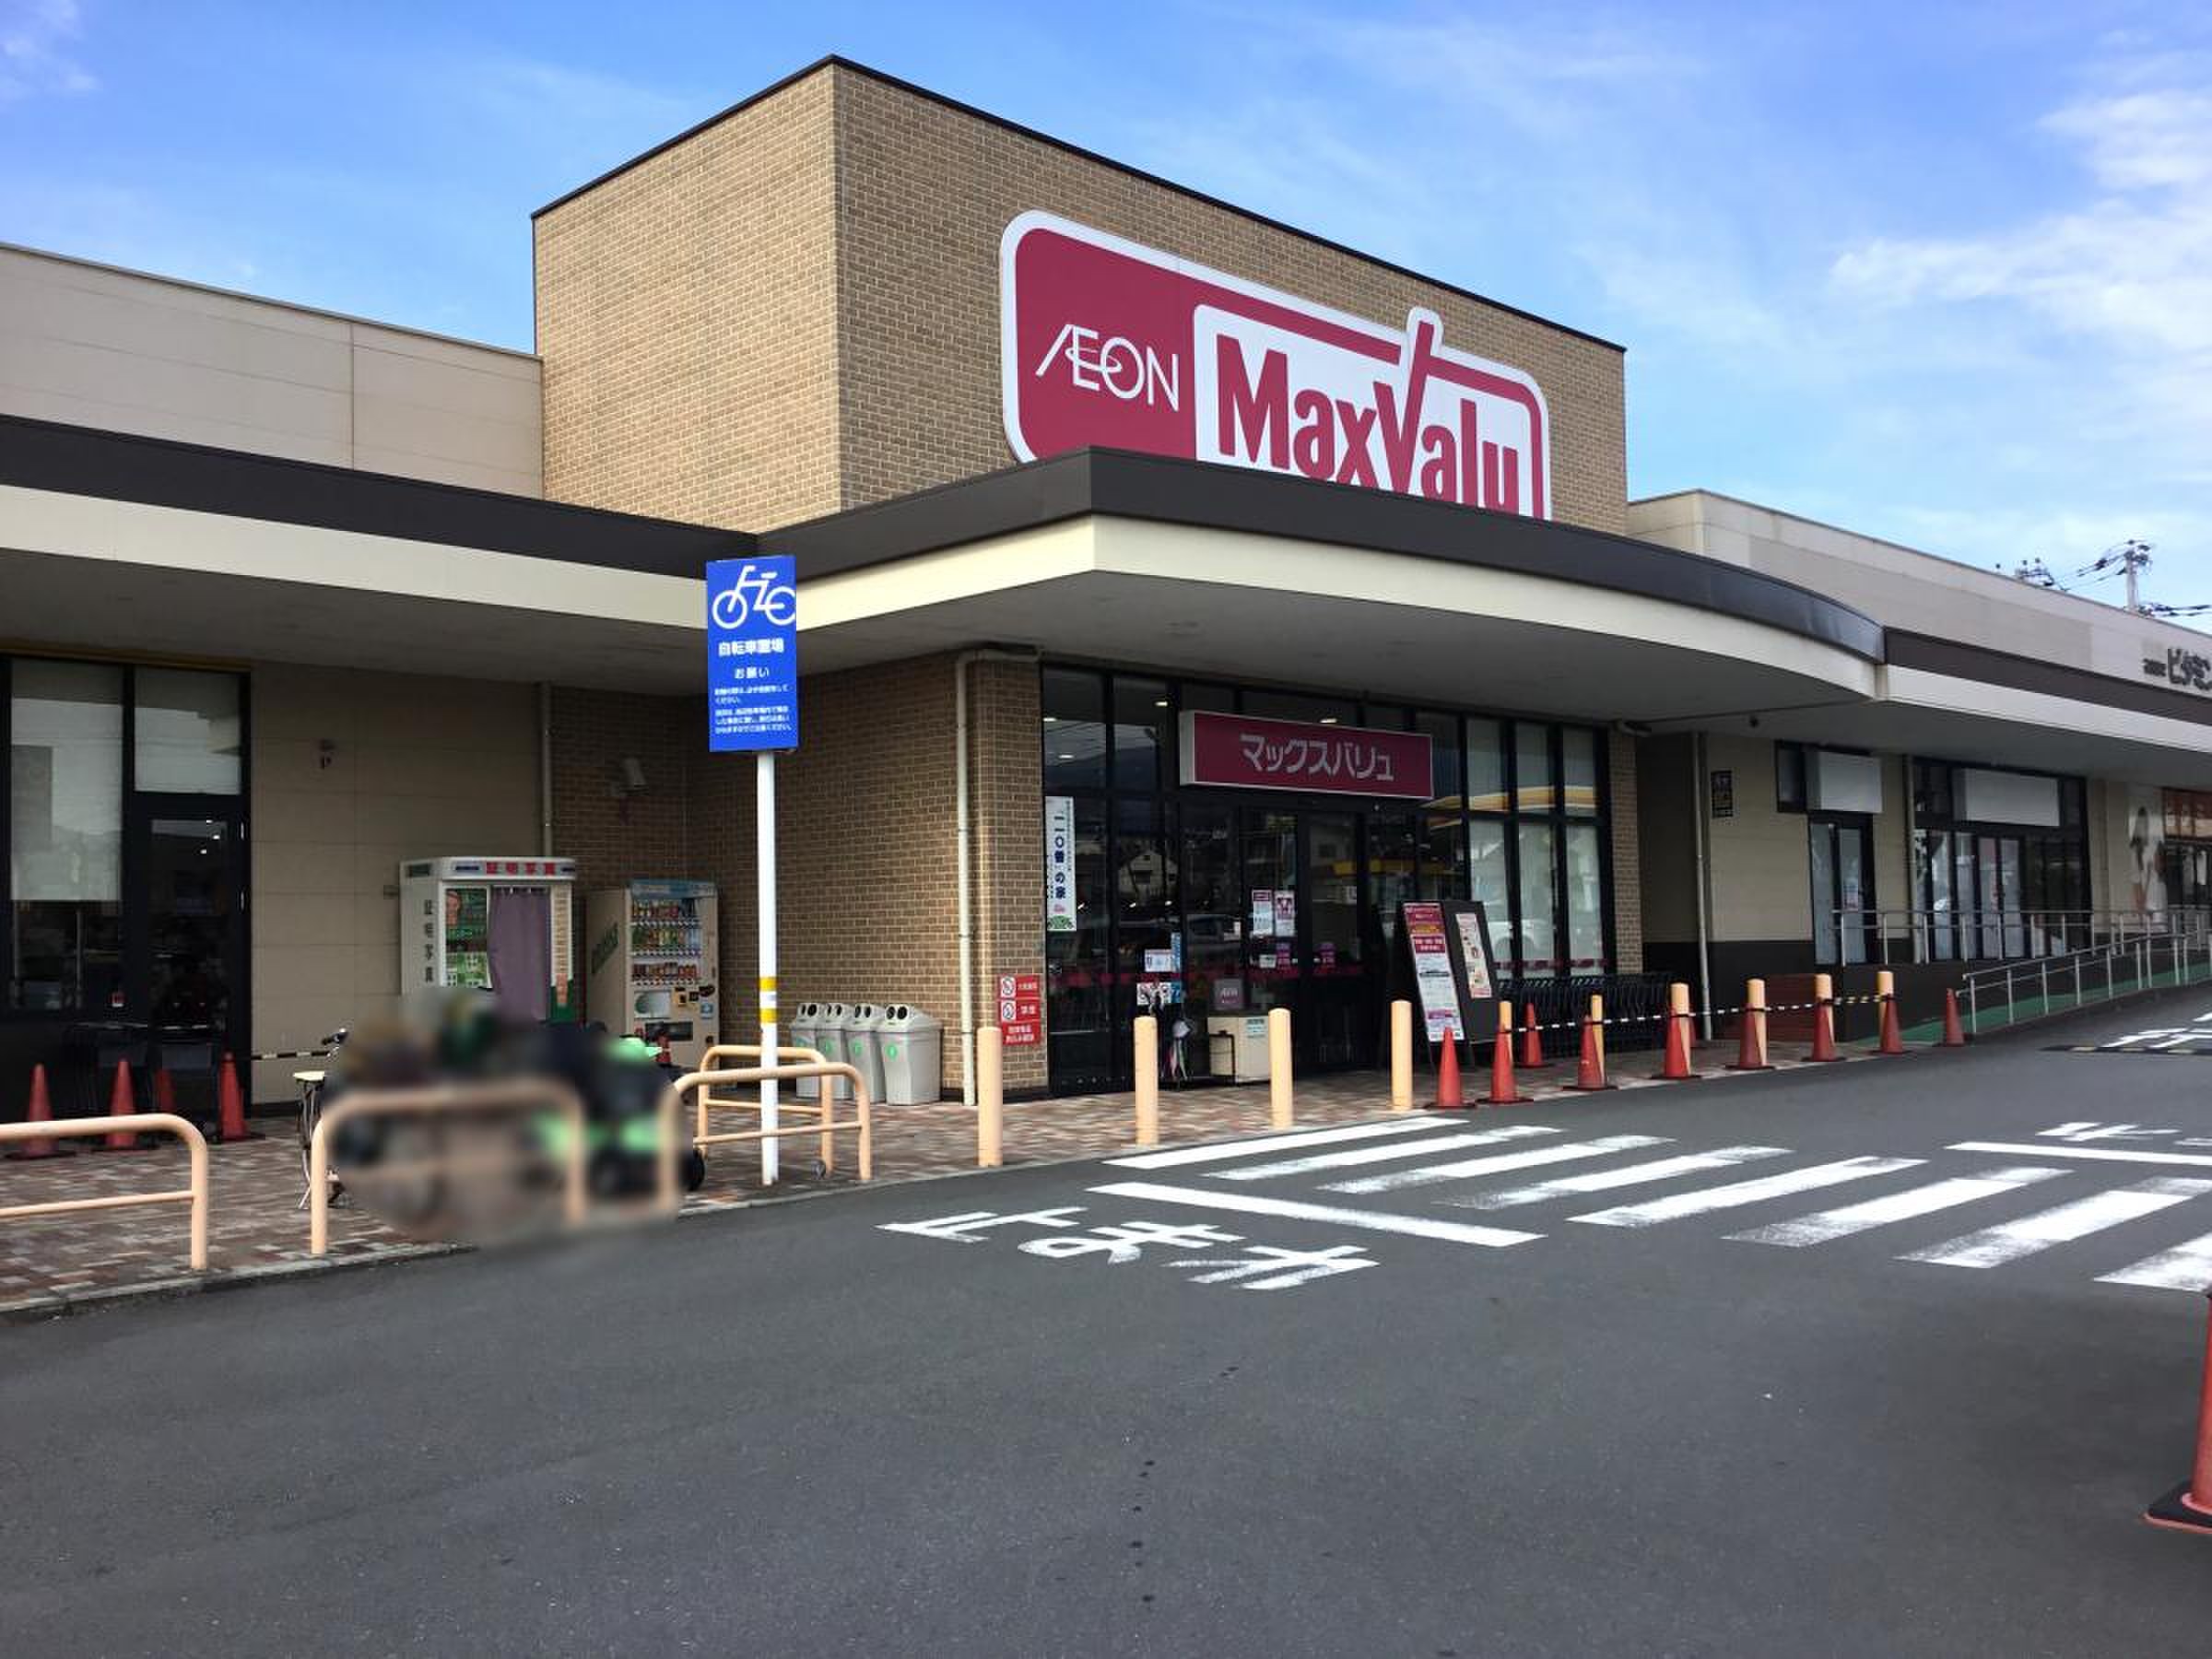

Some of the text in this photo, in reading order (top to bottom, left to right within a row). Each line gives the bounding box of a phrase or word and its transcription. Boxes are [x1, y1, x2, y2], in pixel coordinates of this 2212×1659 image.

[1216, 320, 1520, 517] MaxValu
[1240, 734, 1394, 782] マックスバリュ
[874, 1206, 1380, 1289] 止まれ
